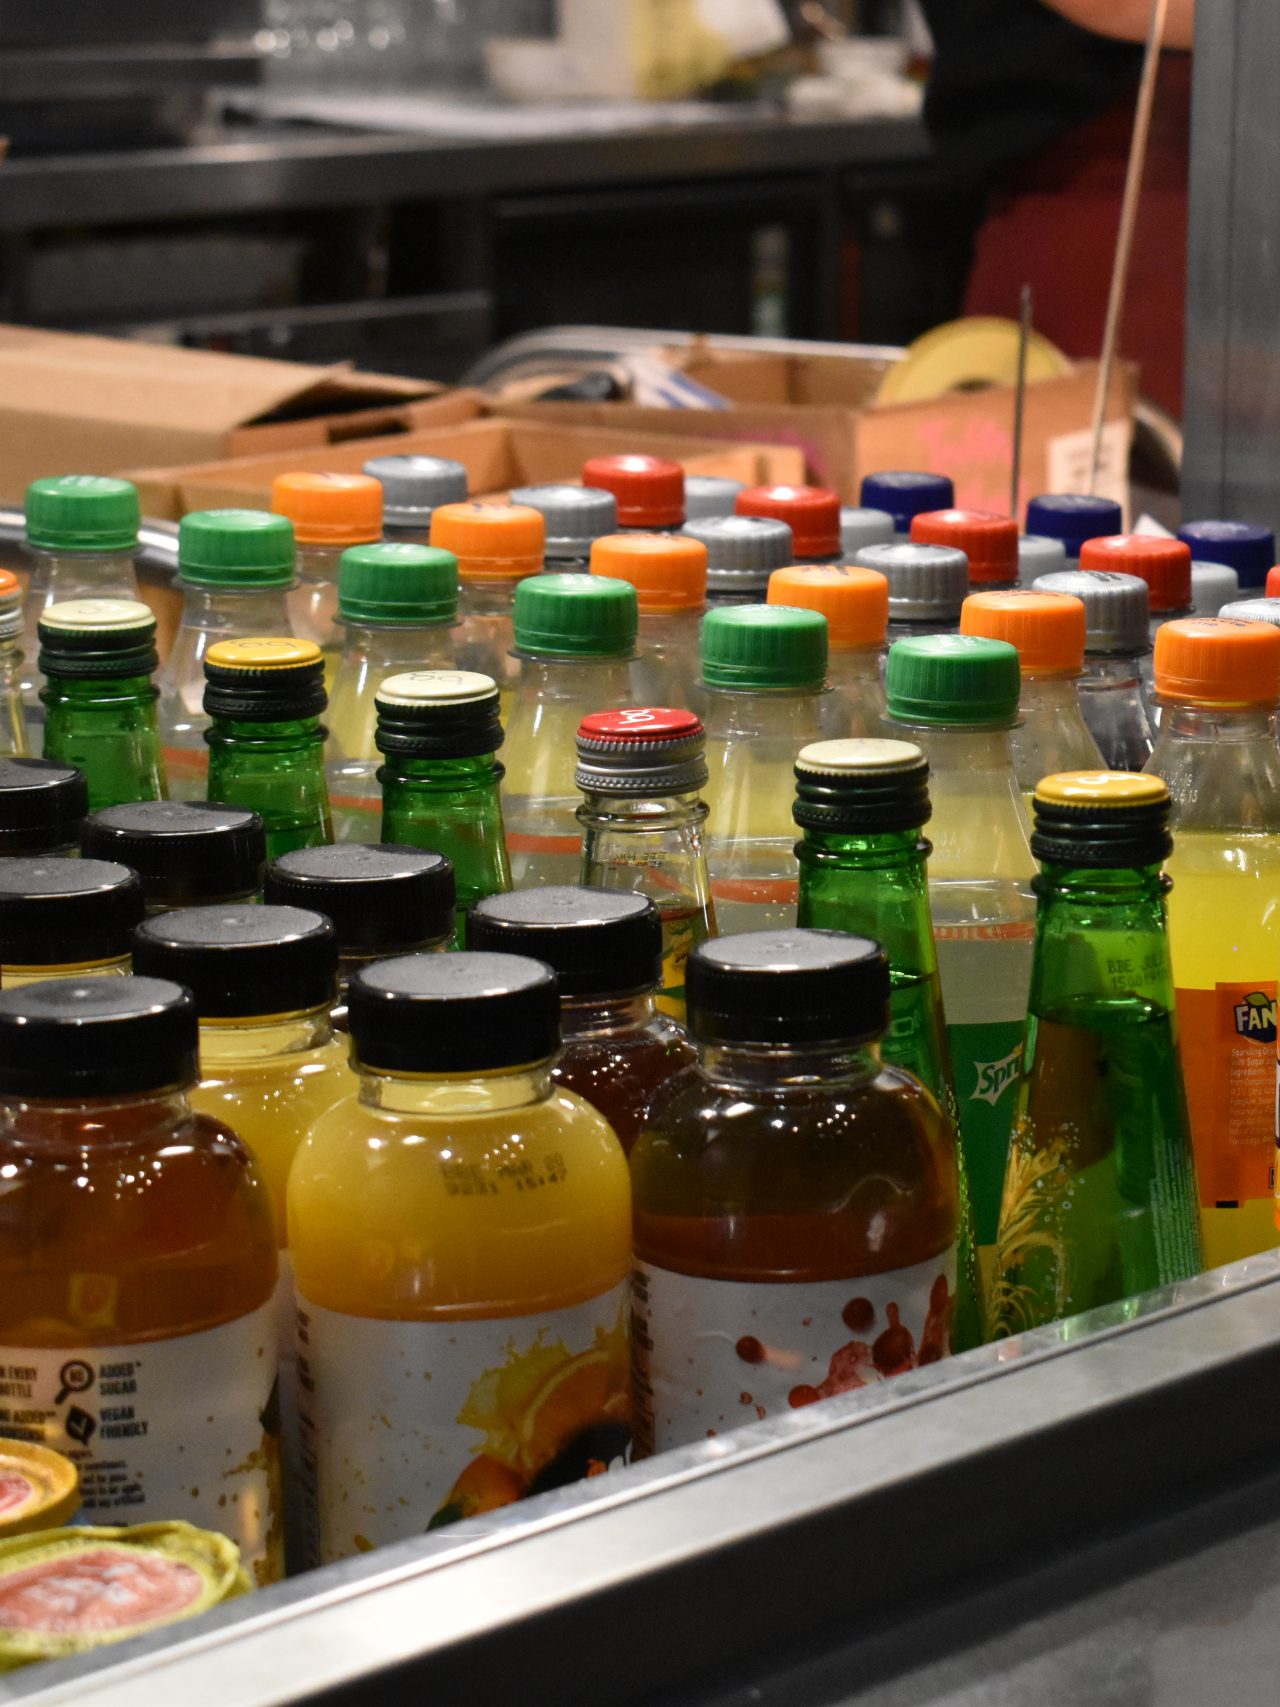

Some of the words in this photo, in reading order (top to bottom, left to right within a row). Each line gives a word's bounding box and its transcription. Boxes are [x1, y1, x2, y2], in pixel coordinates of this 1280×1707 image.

[1235, 1001, 1277, 1032] FAN
[1246, 1057, 1265, 1067] Sugar
[100, 1405, 135, 1422] VEGAN
[101, 1420, 149, 1438] FRIENDLY
